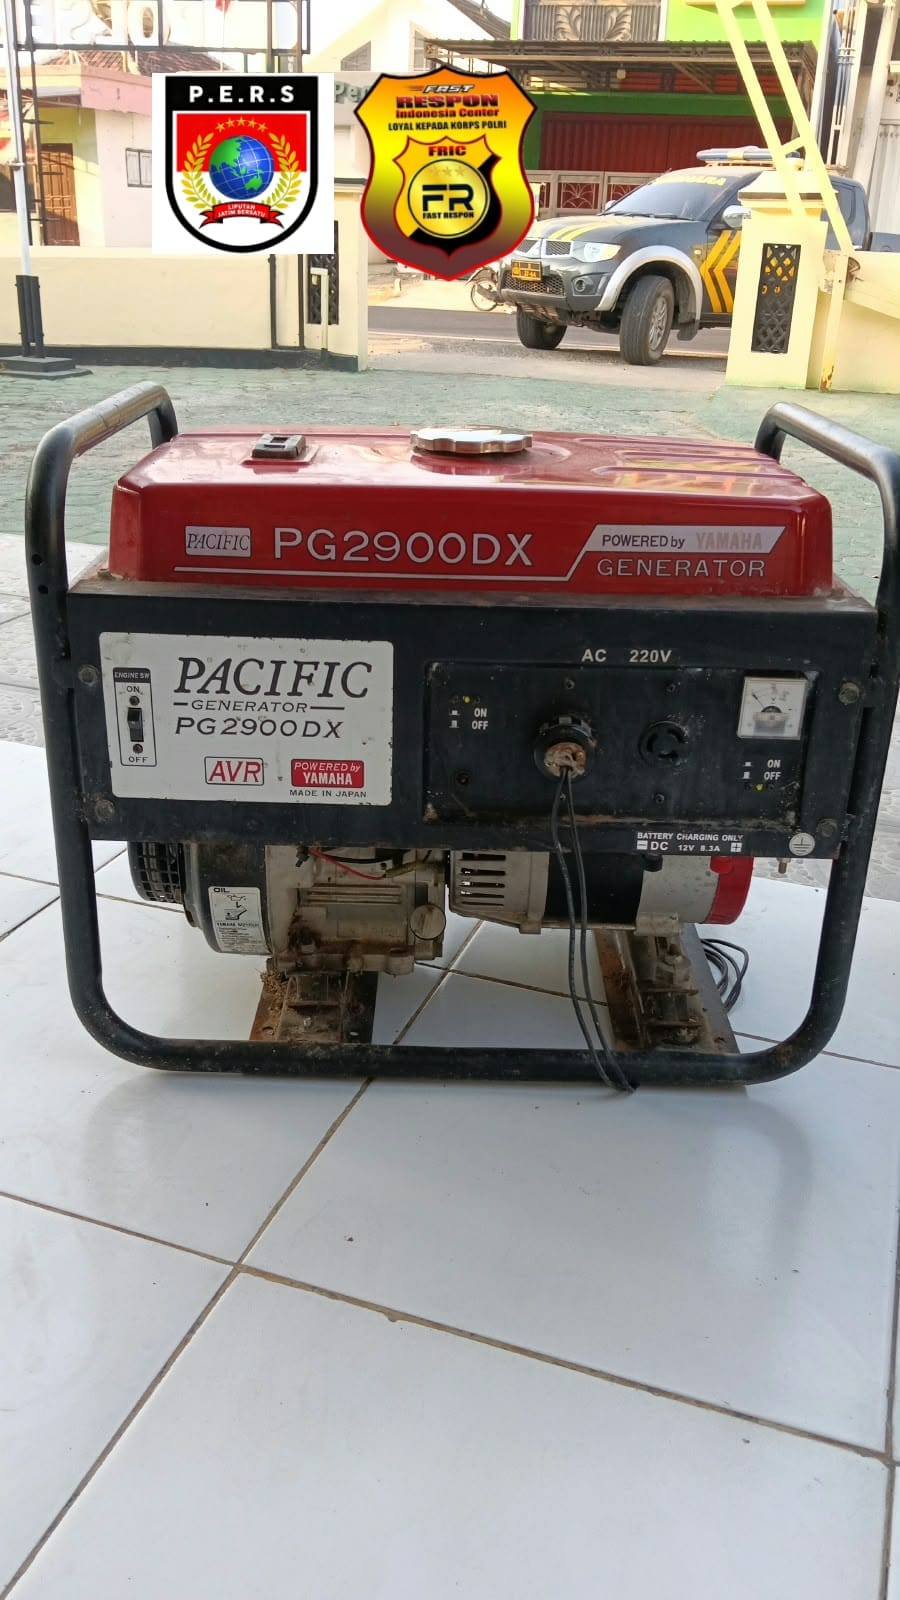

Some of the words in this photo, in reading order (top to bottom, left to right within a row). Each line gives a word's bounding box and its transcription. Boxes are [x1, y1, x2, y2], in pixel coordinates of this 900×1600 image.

[186, 532, 250, 550] PACIFIC
[274, 527, 533, 567] PG2900DX
[601, 534, 668, 548] POWERED
[670, 535, 685, 549] by
[696, 532, 763, 550] YAMAHA
[596, 558, 765, 577] GENERATOR
[581, 649, 607, 663] AC
[629, 649, 672, 663] 220V
[114, 671, 139, 679] ENGINE
[173, 657, 373, 698] PACIFIC
[126, 685, 140, 694] ON
[191, 699, 308, 713] GENERATOR
[474, 708, 487, 717] ON
[175, 717, 345, 738] PG2900DX
[471, 721, 489, 730] OFF
[128, 755, 149, 764] OFF
[767, 760, 781, 769] ON
[208, 760, 262, 784] AVR
[294, 761, 347, 771] POWERED
[350, 763, 361, 773] by
[303, 771, 353, 785] YAMAHA
[763, 771, 782, 781] OFF
[289, 789, 317, 797] MADE
[322, 790, 332, 798] IN
[336, 790, 367, 798] JAPAN
[637, 832, 673, 840] BATTERY
[676, 833, 719, 842] CHARGING
[650, 841, 669, 851] DC
[678, 844, 695, 852] 12V
